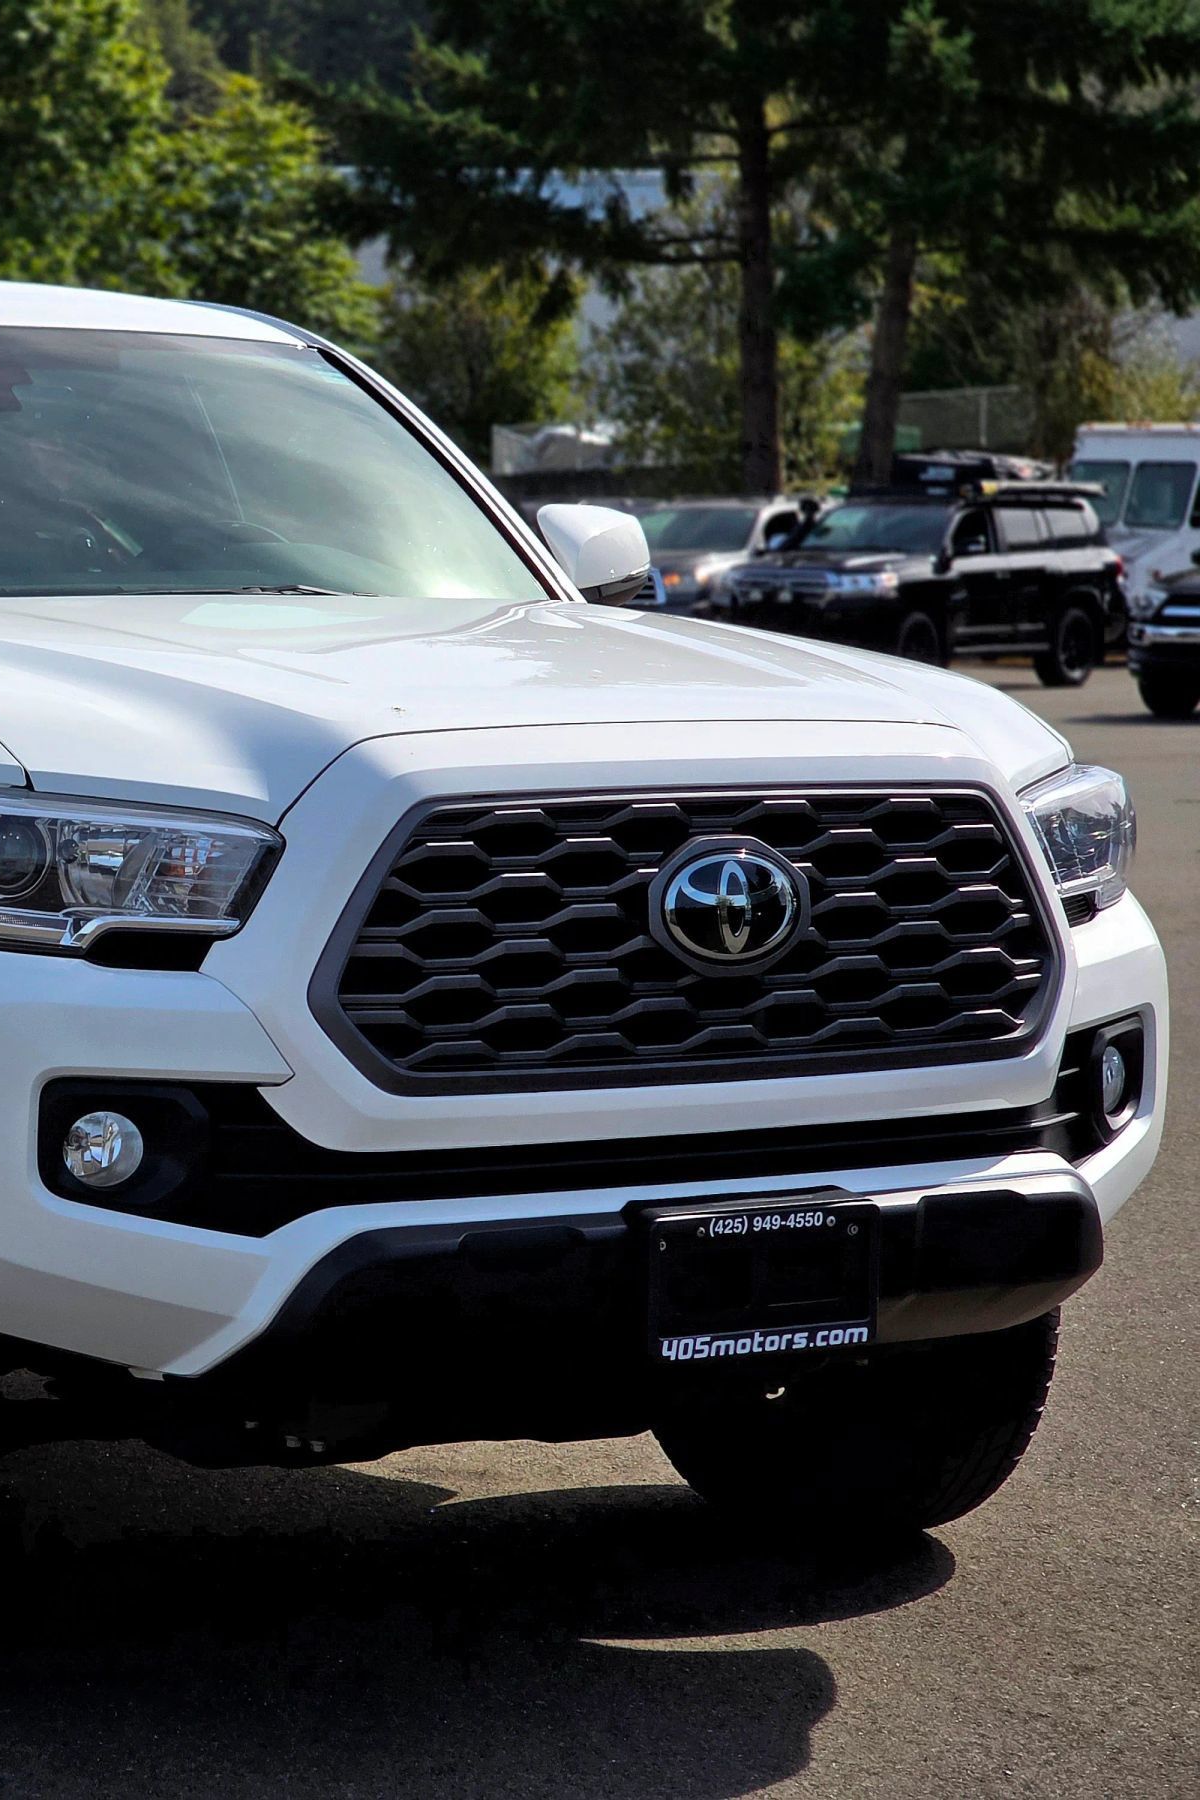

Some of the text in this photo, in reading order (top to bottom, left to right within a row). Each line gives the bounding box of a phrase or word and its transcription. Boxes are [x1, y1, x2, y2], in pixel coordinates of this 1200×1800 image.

[709, 1211, 824, 1238] (425) 949-4550
[661, 1326, 869, 1361] 405motors.com
